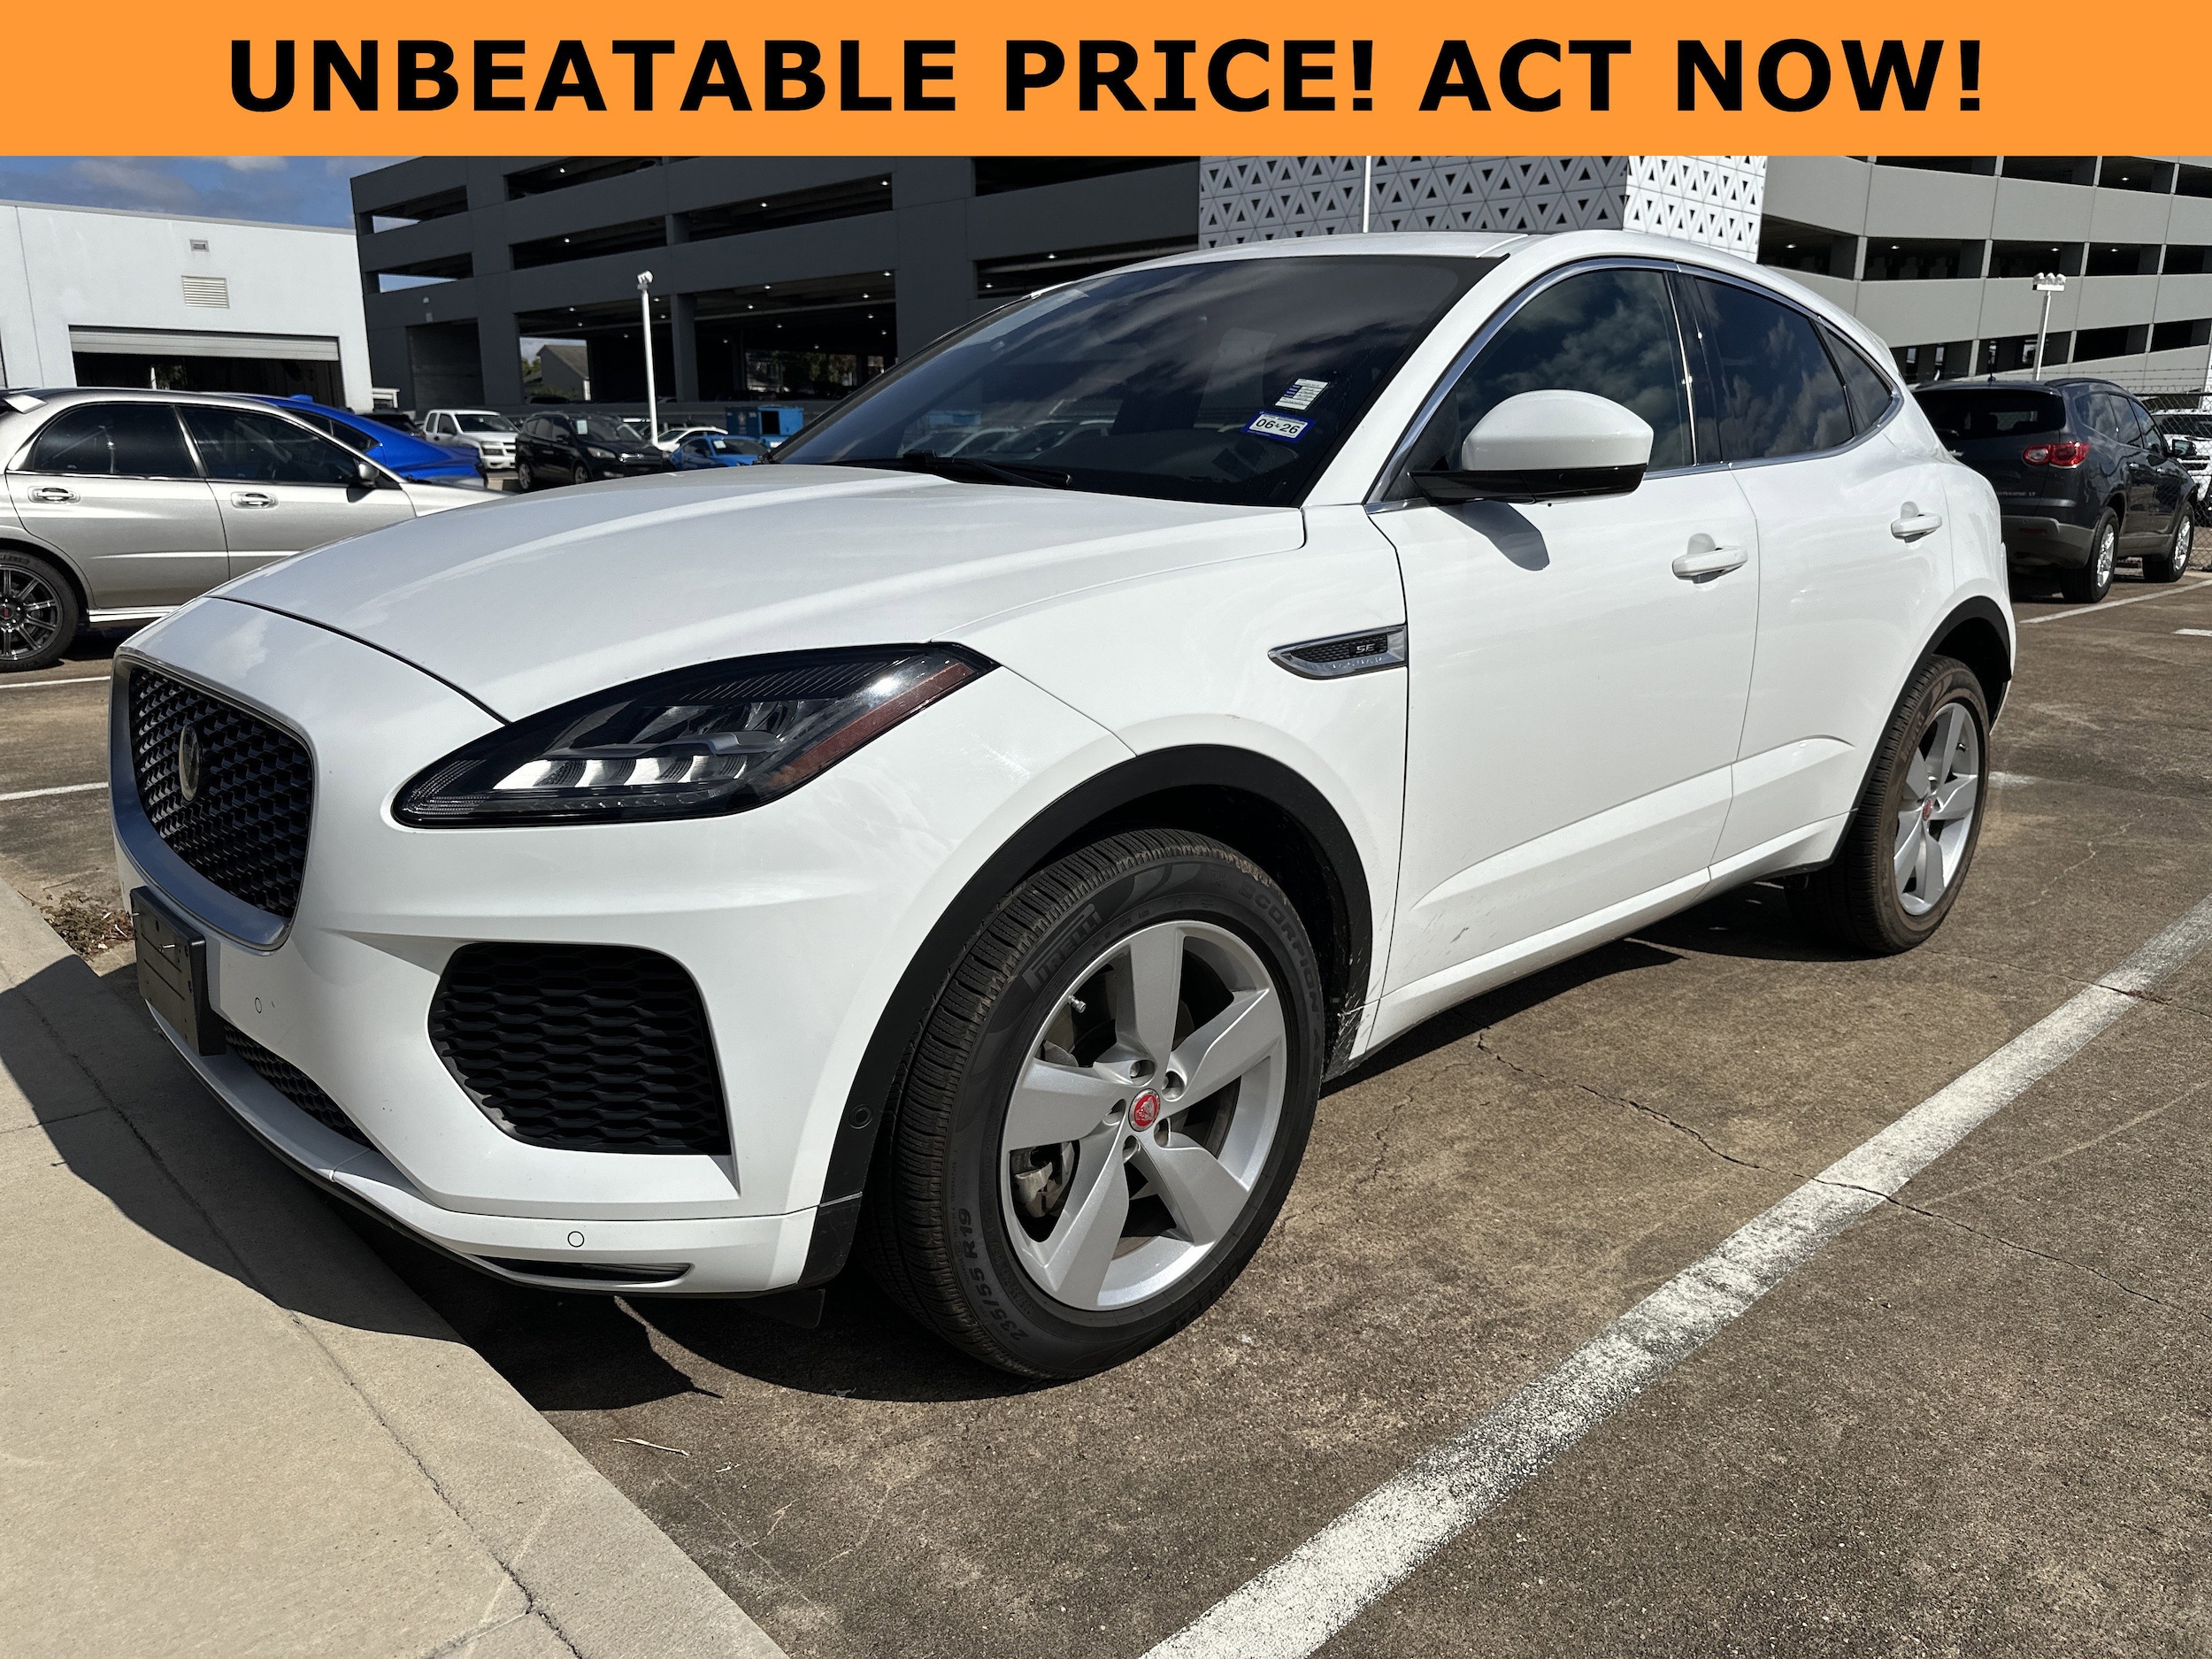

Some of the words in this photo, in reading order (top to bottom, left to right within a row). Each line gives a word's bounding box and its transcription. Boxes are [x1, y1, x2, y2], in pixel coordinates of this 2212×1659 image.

[1256, 419, 1276, 429] 06
[1279, 423, 1301, 434] 26
[1356, 643, 1376, 654] SE
[1022, 902, 1103, 994] PIRELLI
[1238, 882, 1319, 1013] SCORPION
[958, 1208, 979, 1259] R19
[968, 1266, 1030, 1341] 235/55
